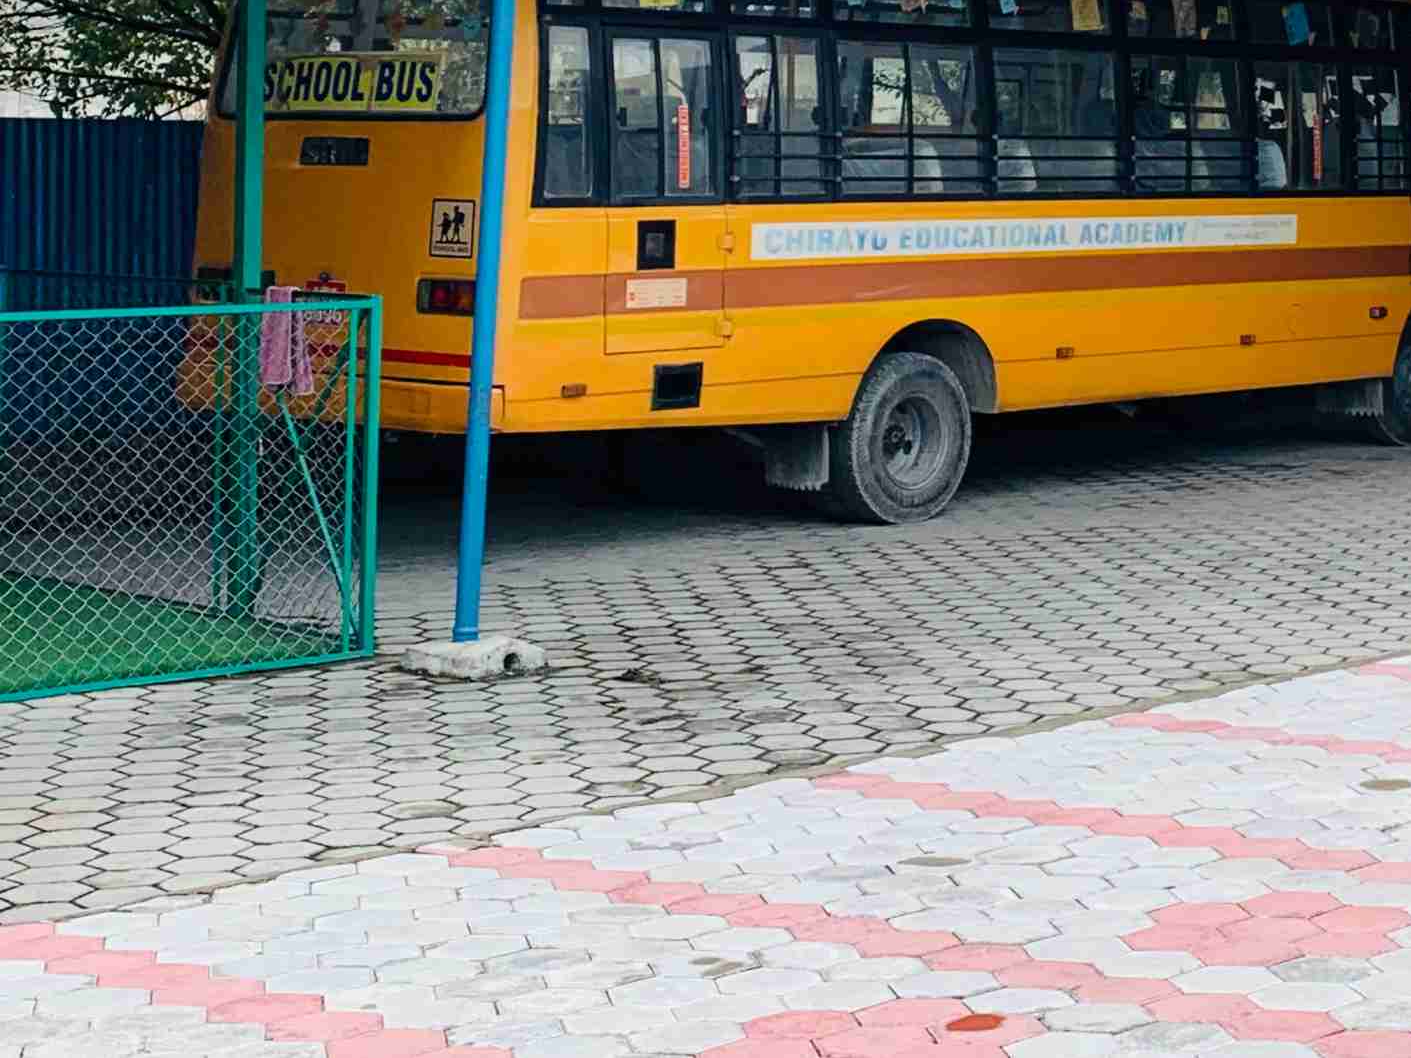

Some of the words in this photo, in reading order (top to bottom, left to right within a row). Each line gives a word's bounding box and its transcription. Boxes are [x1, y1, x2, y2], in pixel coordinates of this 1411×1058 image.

[263, 60, 365, 102] SCHOOL
[374, 60, 436, 102] BUS
[765, 227, 888, 254] CHIRAYU
[899, 222, 1071, 249] EDUCATIONAL
[1080, 221, 1188, 245] ACADEMY
